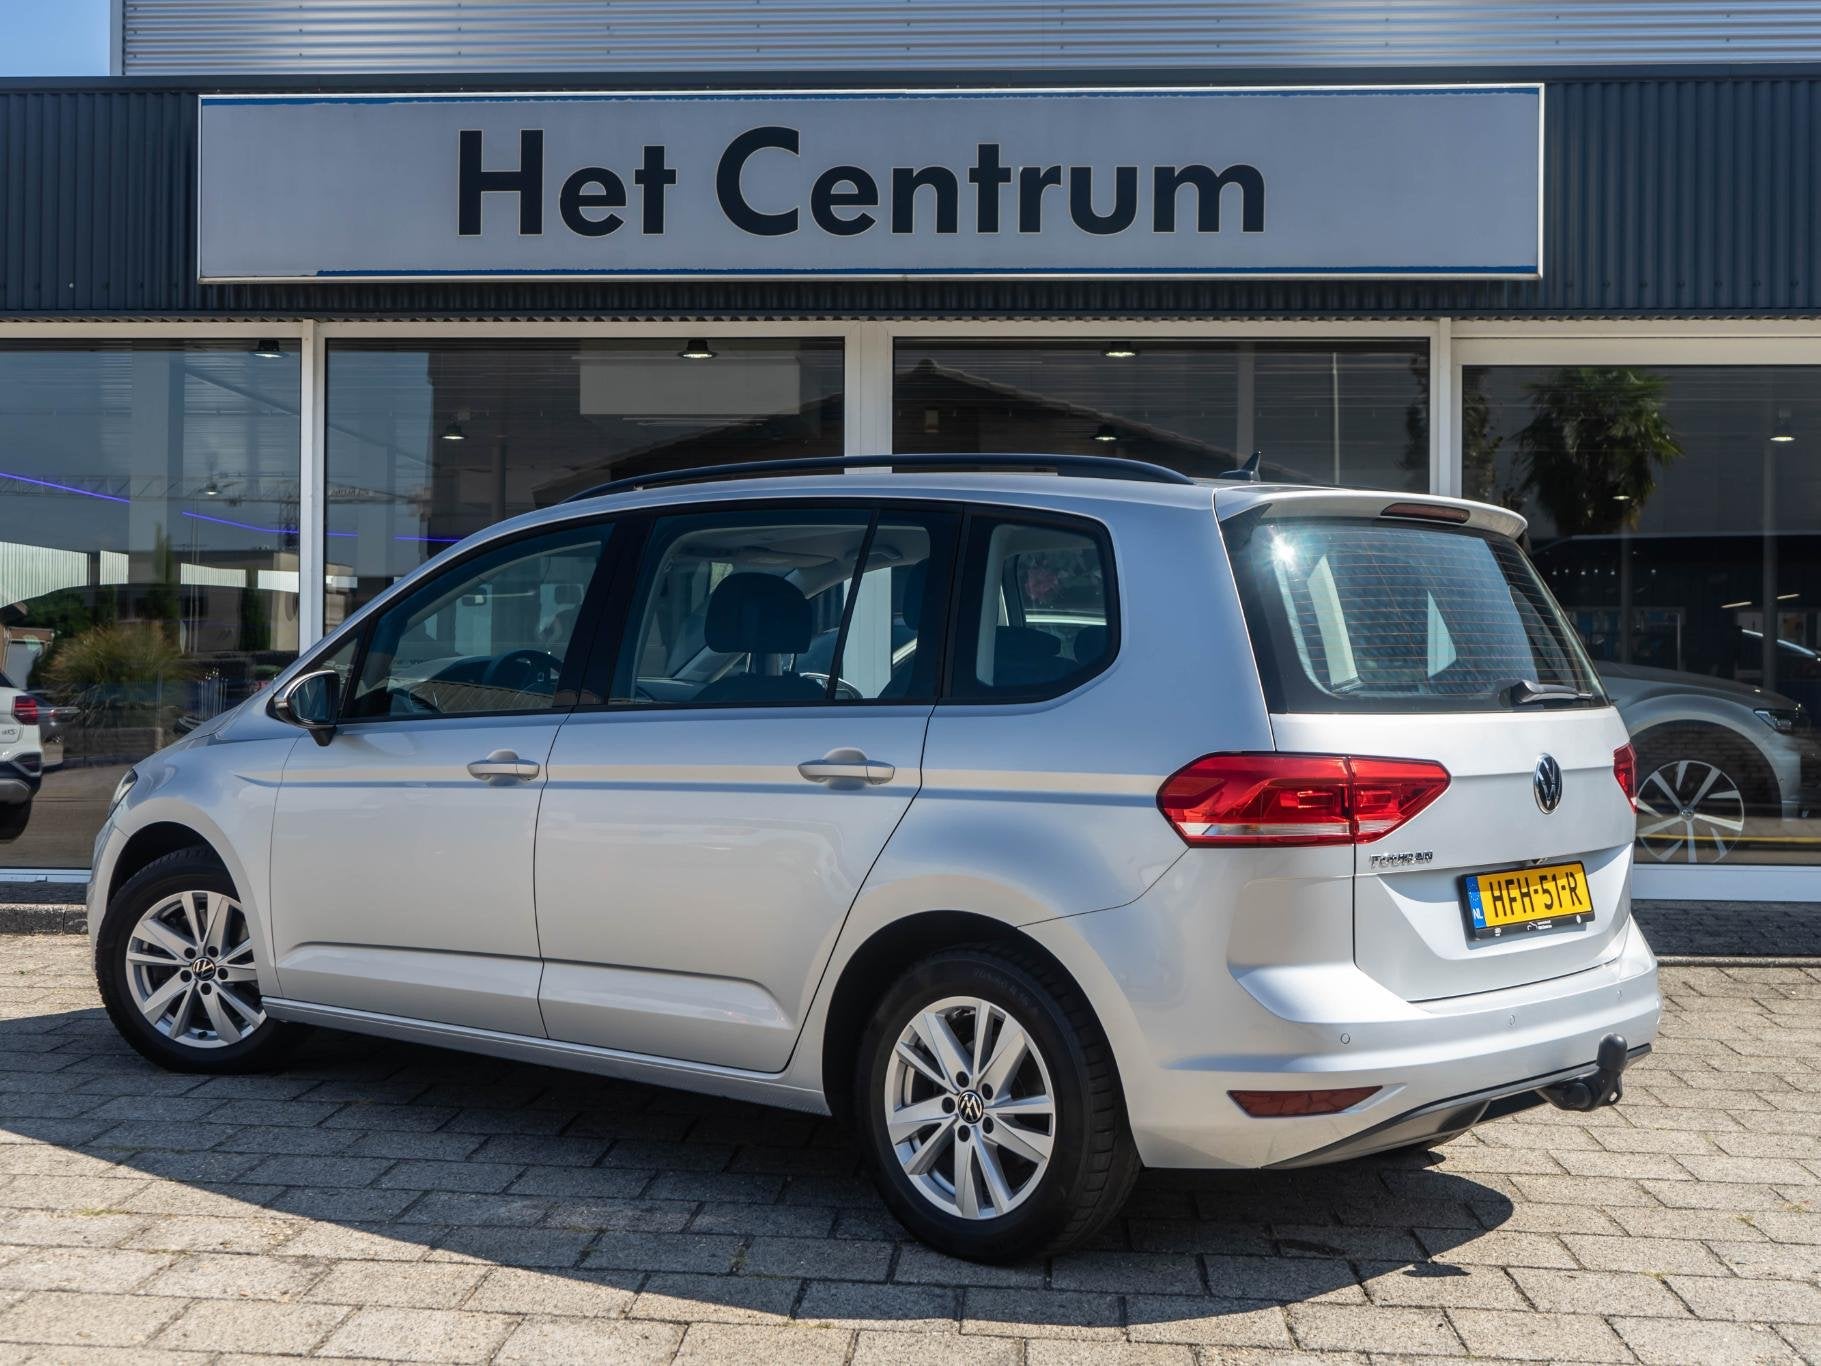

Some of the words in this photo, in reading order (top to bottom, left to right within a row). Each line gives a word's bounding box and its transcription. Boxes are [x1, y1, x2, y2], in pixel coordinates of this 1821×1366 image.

[457, 128, 676, 237] Het
[715, 125, 1266, 236] Centrum
[1488, 871, 1583, 918] HFH-51-R
